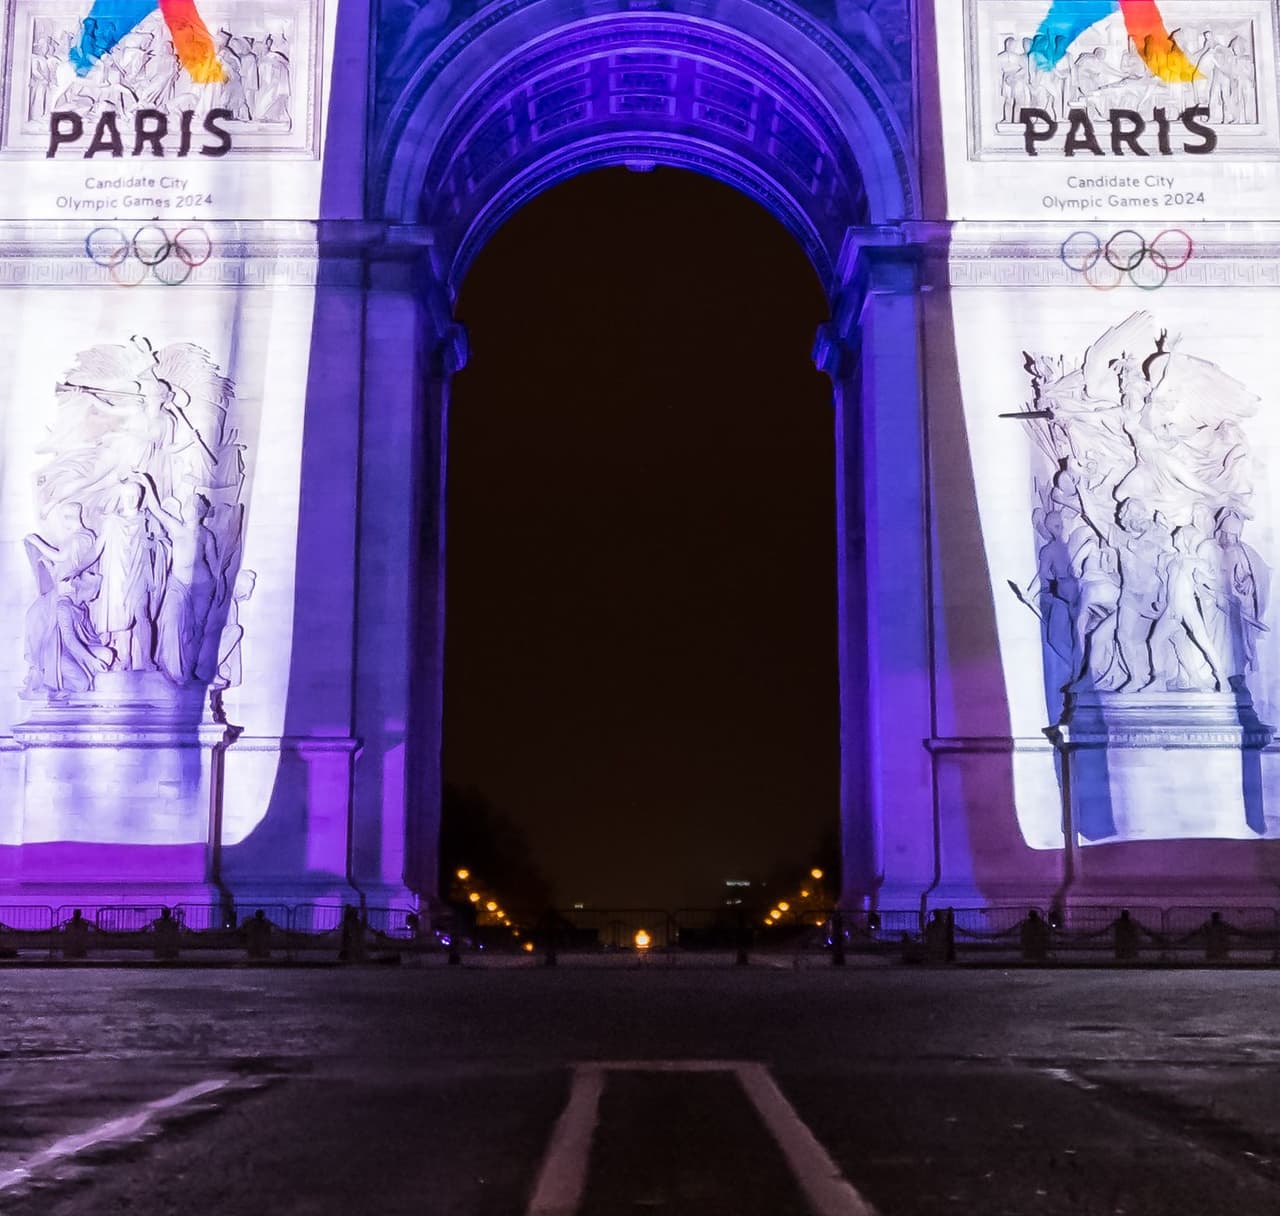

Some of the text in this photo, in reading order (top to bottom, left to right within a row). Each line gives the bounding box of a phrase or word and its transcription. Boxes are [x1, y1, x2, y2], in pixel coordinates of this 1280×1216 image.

[46, 109, 234, 159] PARIS
[1019, 104, 1218, 157] PARIS
[84, 175, 188, 191] Candidate City
[1066, 174, 1175, 189] Candidate City
[55, 193, 213, 211] Olympic Games 2024
[1042, 191, 1205, 211] Olympic Games 2024
